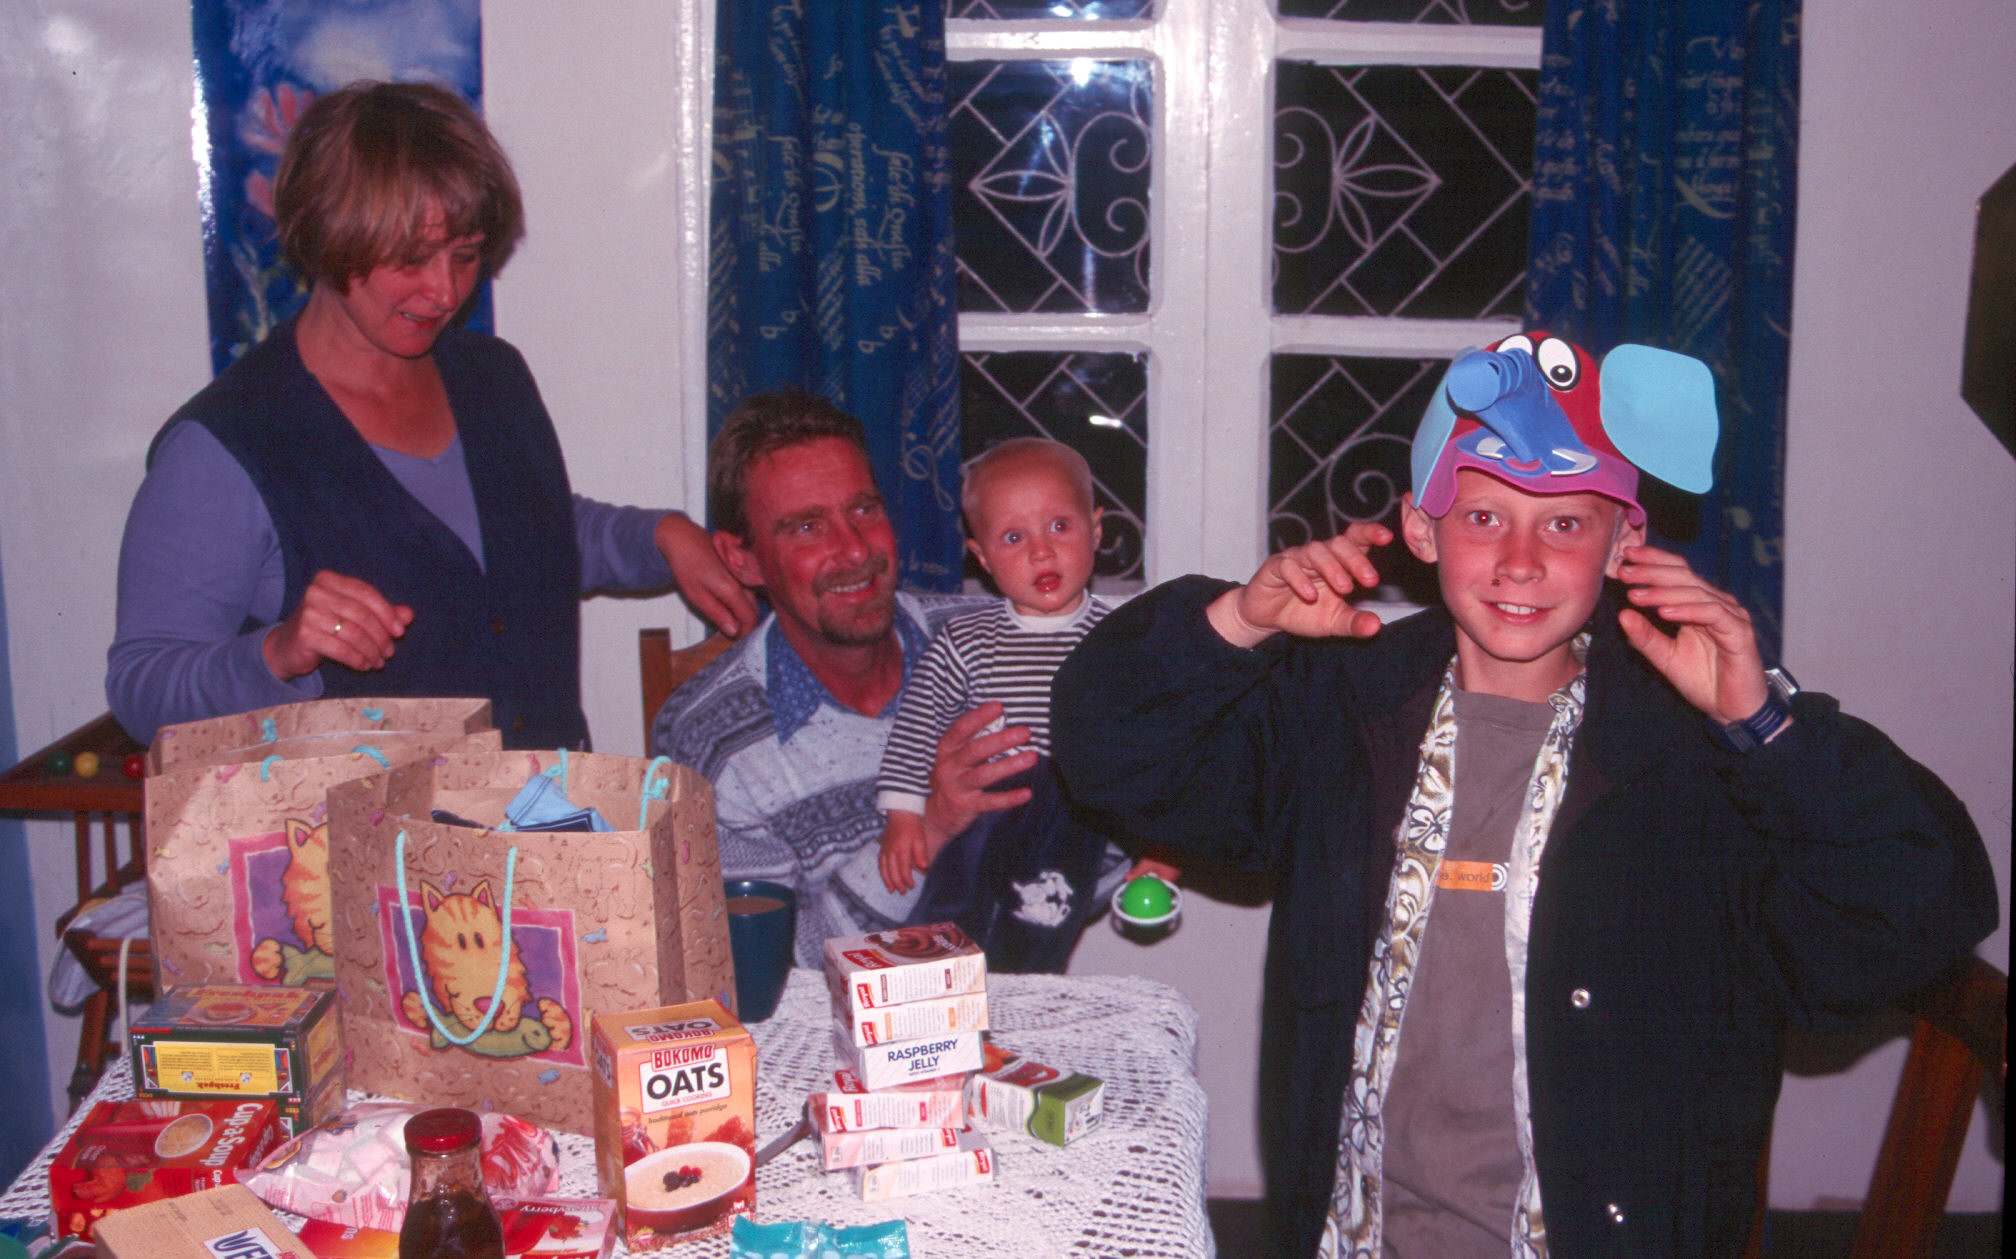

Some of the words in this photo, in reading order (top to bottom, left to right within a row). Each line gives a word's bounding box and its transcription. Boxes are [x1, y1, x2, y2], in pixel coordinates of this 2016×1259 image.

[1457, 871, 1490, 883] world
[631, 1021, 713, 1036] OATS
[650, 1029, 712, 1041] BOKOMO
[653, 1045, 713, 1069] BOKOMO
[887, 1039, 958, 1062] RASPBERRY
[908, 1055, 940, 1071] JELLY
[646, 1062, 725, 1100] OATS
